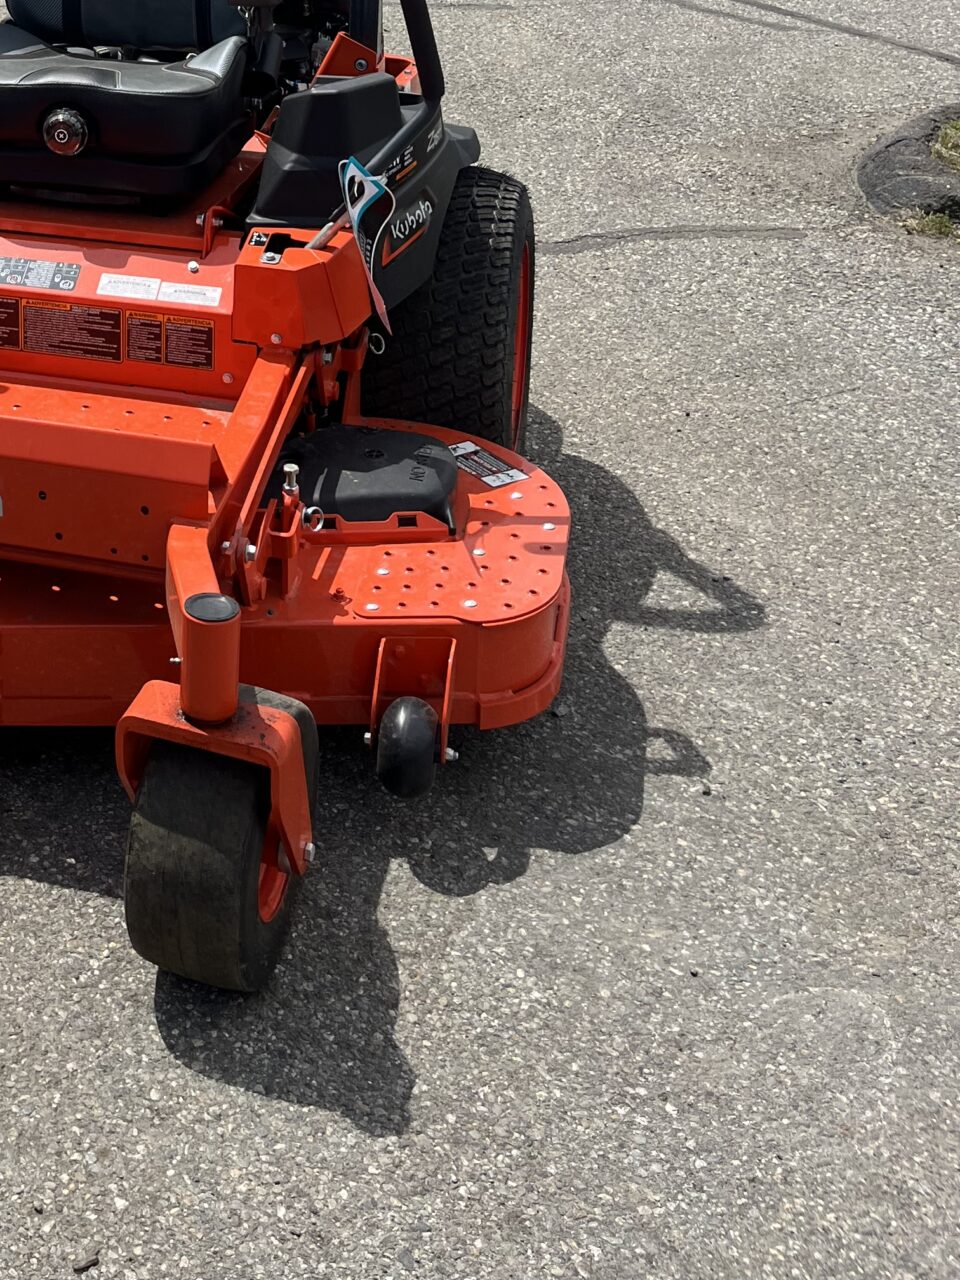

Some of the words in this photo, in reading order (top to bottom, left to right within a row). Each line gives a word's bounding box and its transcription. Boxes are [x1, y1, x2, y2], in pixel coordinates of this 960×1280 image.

[391, 199, 433, 239] Kubota
[31, 300, 68, 308] ADVERTENCIA
[172, 317, 212, 326] ADVERTENCIA
